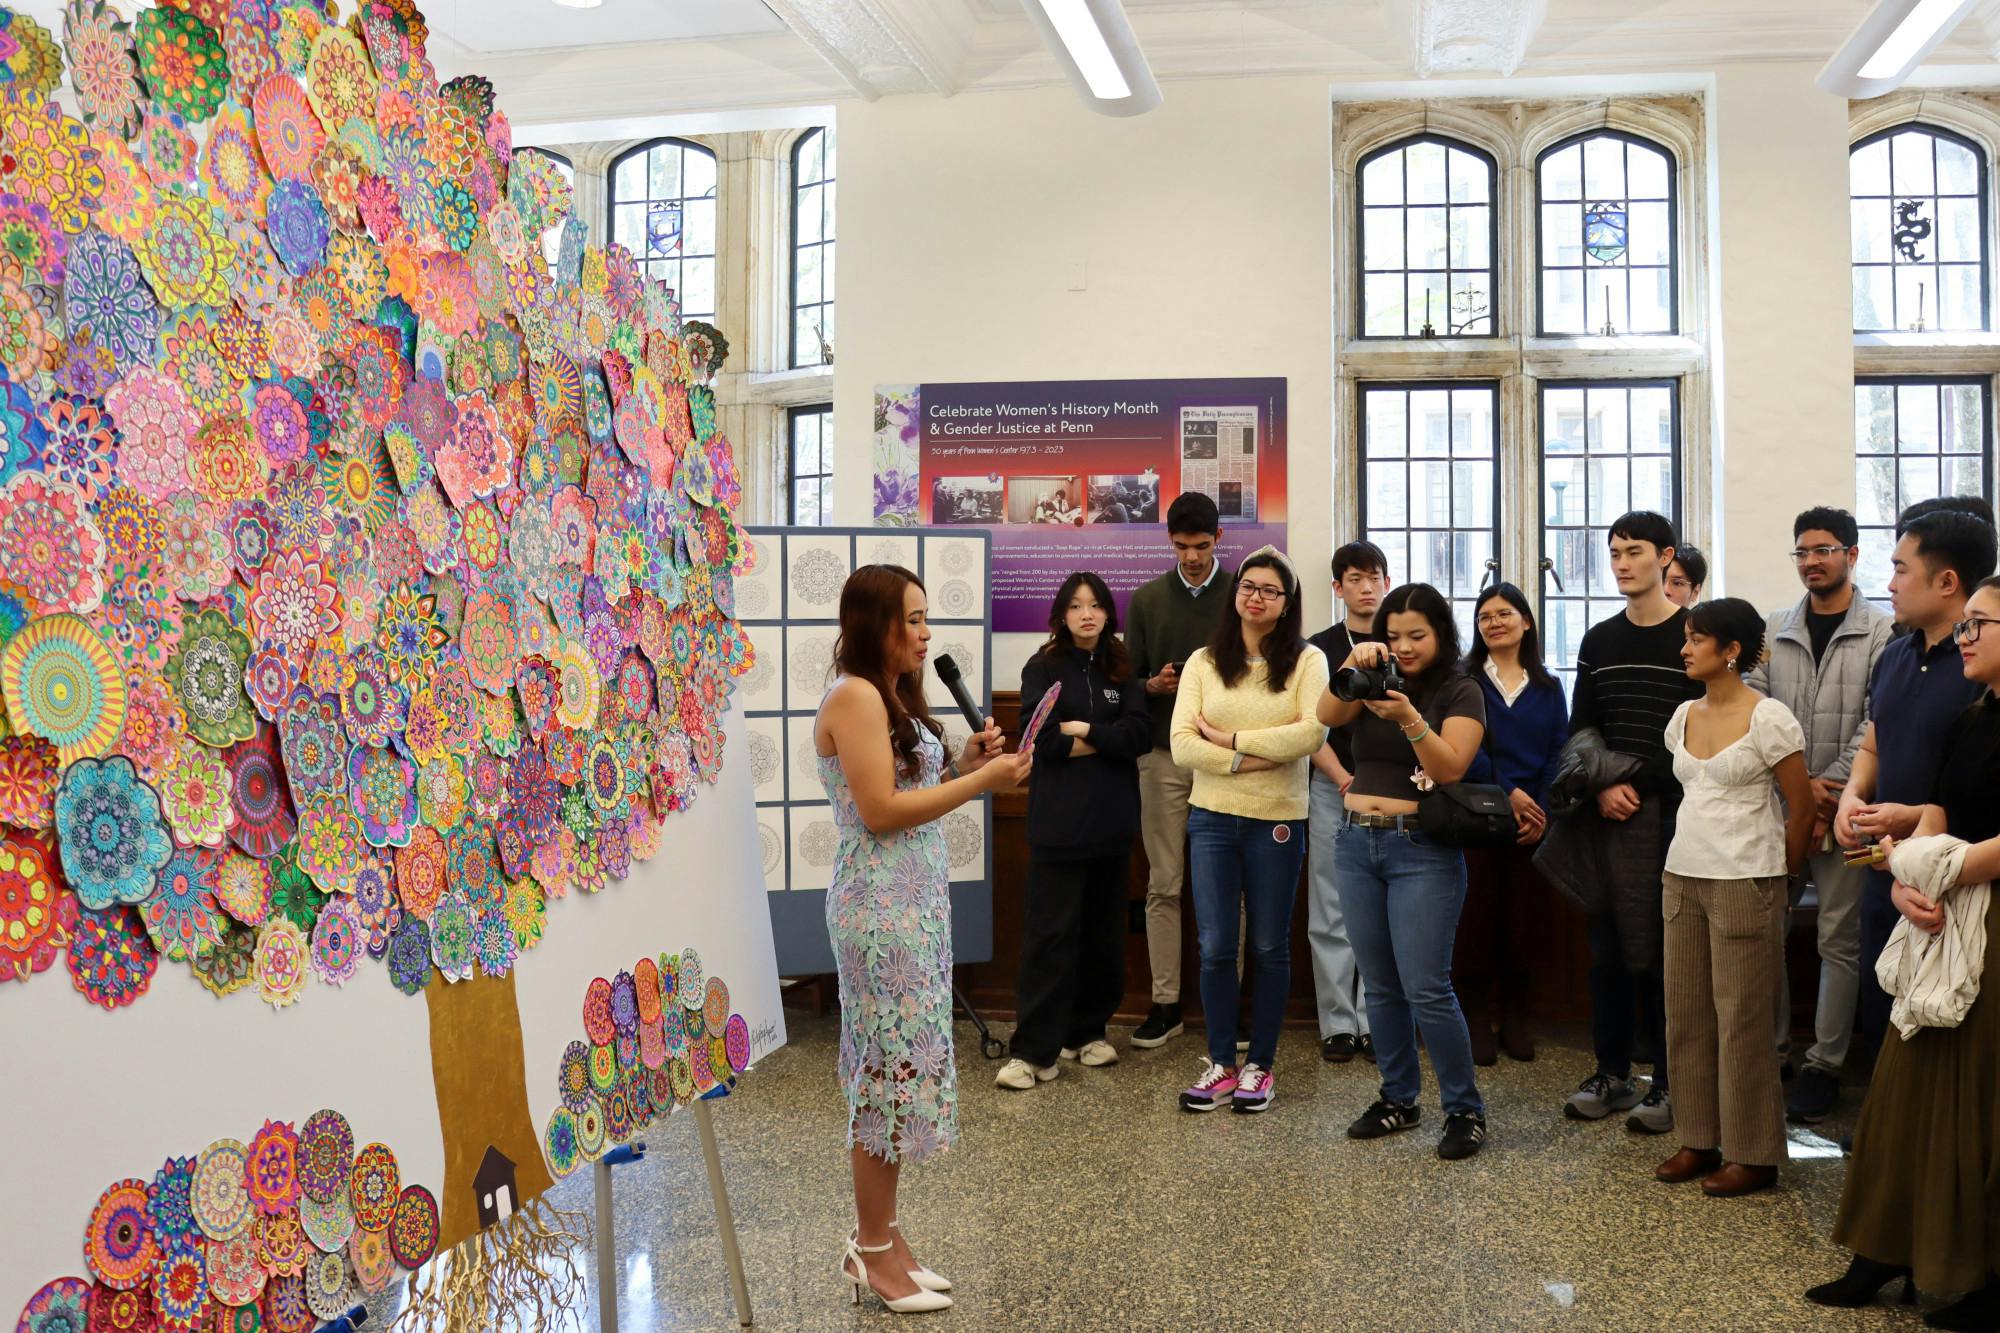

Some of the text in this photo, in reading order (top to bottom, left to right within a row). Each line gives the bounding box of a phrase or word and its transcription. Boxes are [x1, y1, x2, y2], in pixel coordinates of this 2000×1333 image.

[929, 401, 1159, 418] Celebrate Women's History Month
[930, 420, 1094, 436] & Gender Justice at Penn
[943, 447, 957, 459] years
[999, 445, 1019, 455] Center
[1019, 445, 1037, 455] 1973
[1044, 444, 1064, 454] 2023
